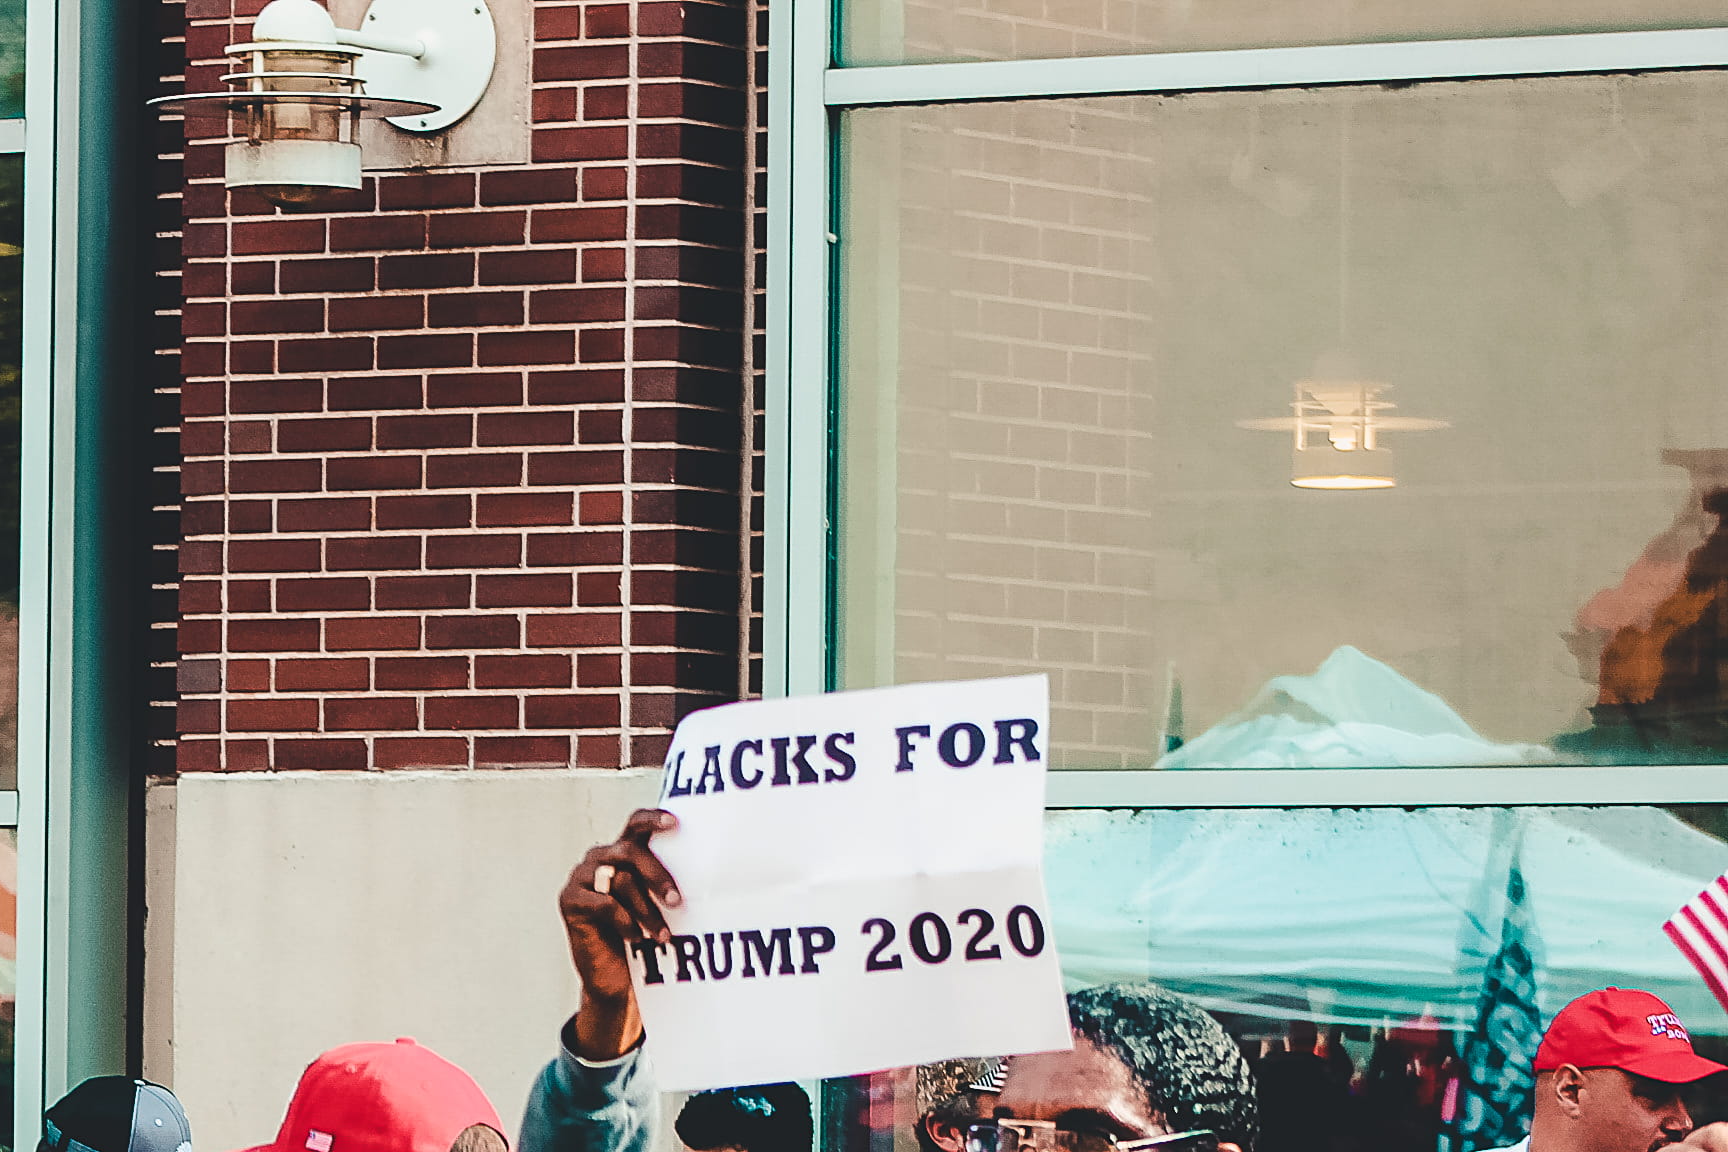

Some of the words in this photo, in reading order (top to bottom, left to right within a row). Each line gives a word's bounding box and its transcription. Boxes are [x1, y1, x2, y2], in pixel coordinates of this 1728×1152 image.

[659, 731, 858, 802] LACKS
[894, 717, 1042, 774] FOR
[631, 925, 837, 986] TRUMP
[859, 903, 1047, 974] 2020
